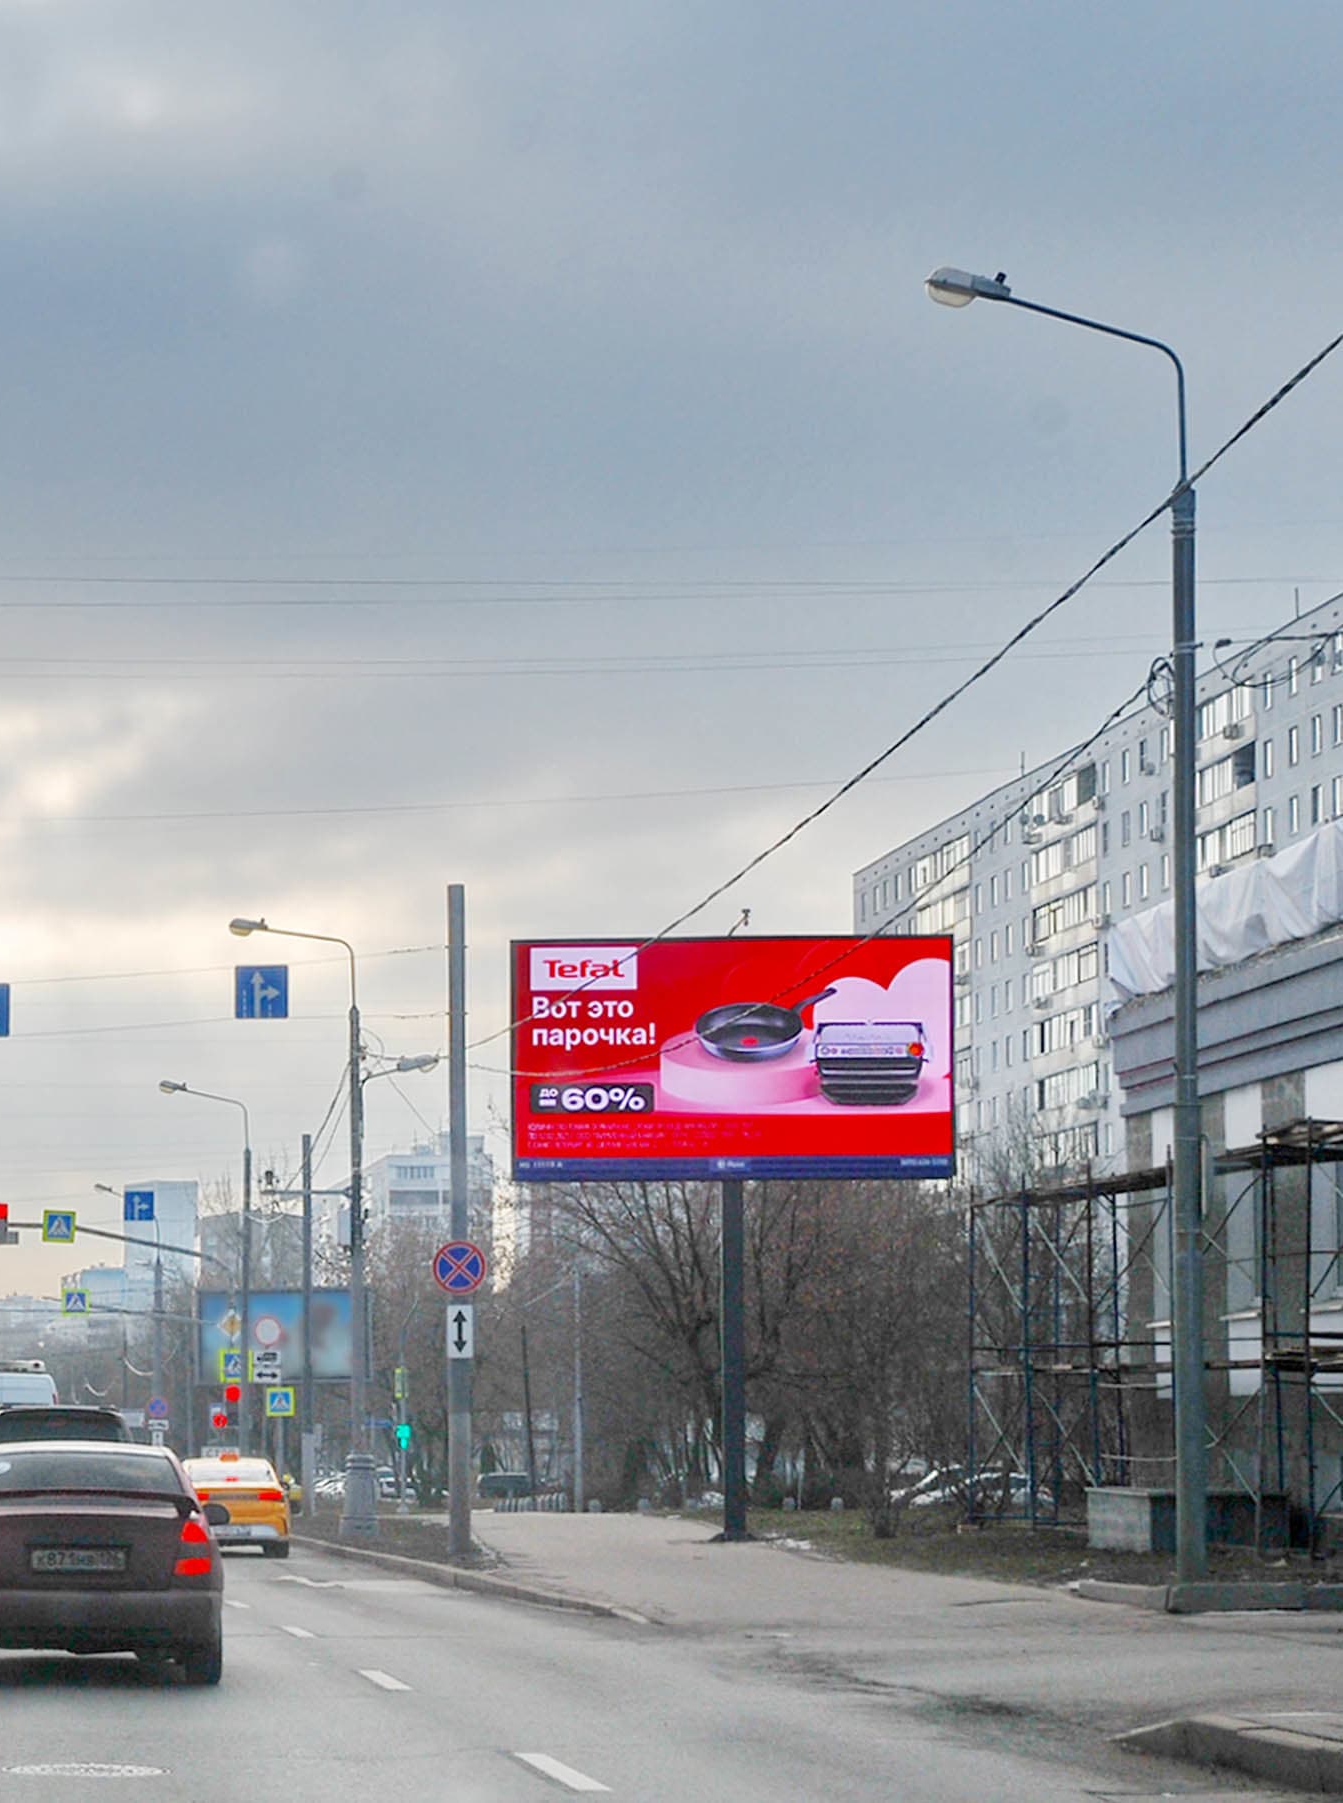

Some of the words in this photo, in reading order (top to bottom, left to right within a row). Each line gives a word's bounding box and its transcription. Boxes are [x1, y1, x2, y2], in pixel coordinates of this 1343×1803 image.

[543, 959, 625, 978] Tefal
[532, 996, 582, 1018] Вот
[587, 1000, 634, 1018] это
[532, 1022, 656, 1050] парочка!
